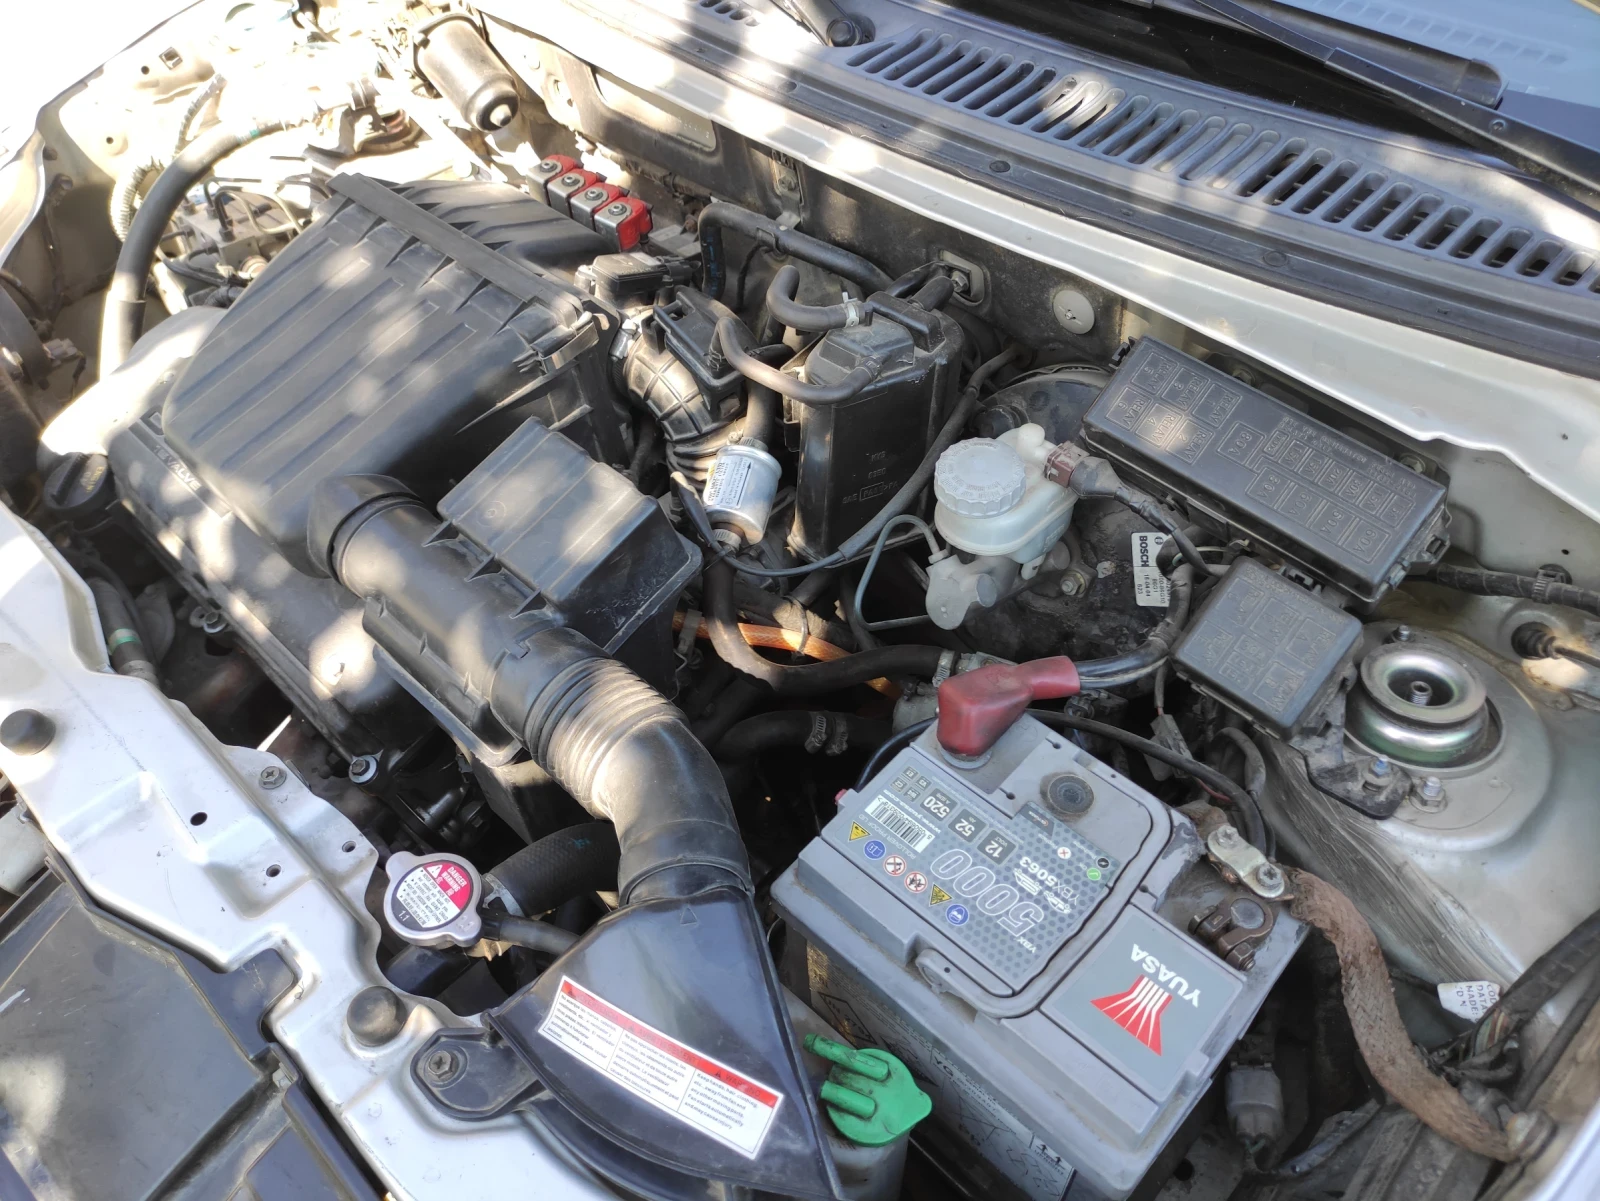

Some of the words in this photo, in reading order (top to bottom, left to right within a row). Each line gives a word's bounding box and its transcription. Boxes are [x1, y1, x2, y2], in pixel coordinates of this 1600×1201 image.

[1145, 361, 1171, 390] RELAY
[1177, 377, 1202, 406] RELAY
[1120, 397, 1146, 426] RELAY
[1208, 394, 1233, 423] RELAY
[1150, 413, 1175, 442] RELAY
[1181, 429, 1207, 459] RELAY
[1139, 535, 1148, 566] BOSCH
[882, 787, 942, 833] www.yuasa.com
[922, 793, 951, 819] 520
[866, 820, 887, 837] PROOF
[953, 816, 976, 838] 52
[994, 834, 1008, 847] VOLT
[885, 833, 916, 860] ROLLOVER
[983, 838, 1004, 859] 12
[440, 870, 461, 892] WARNING
[447, 866, 467, 887] DANGER
[1017, 854, 1083, 905] YBX5063
[929, 848, 1045, 937] 5000
[397, 909, 410, 921] 1.1
[1127, 942, 1199, 1008] YUASA
[724, 1073, 761, 1097] WARING
